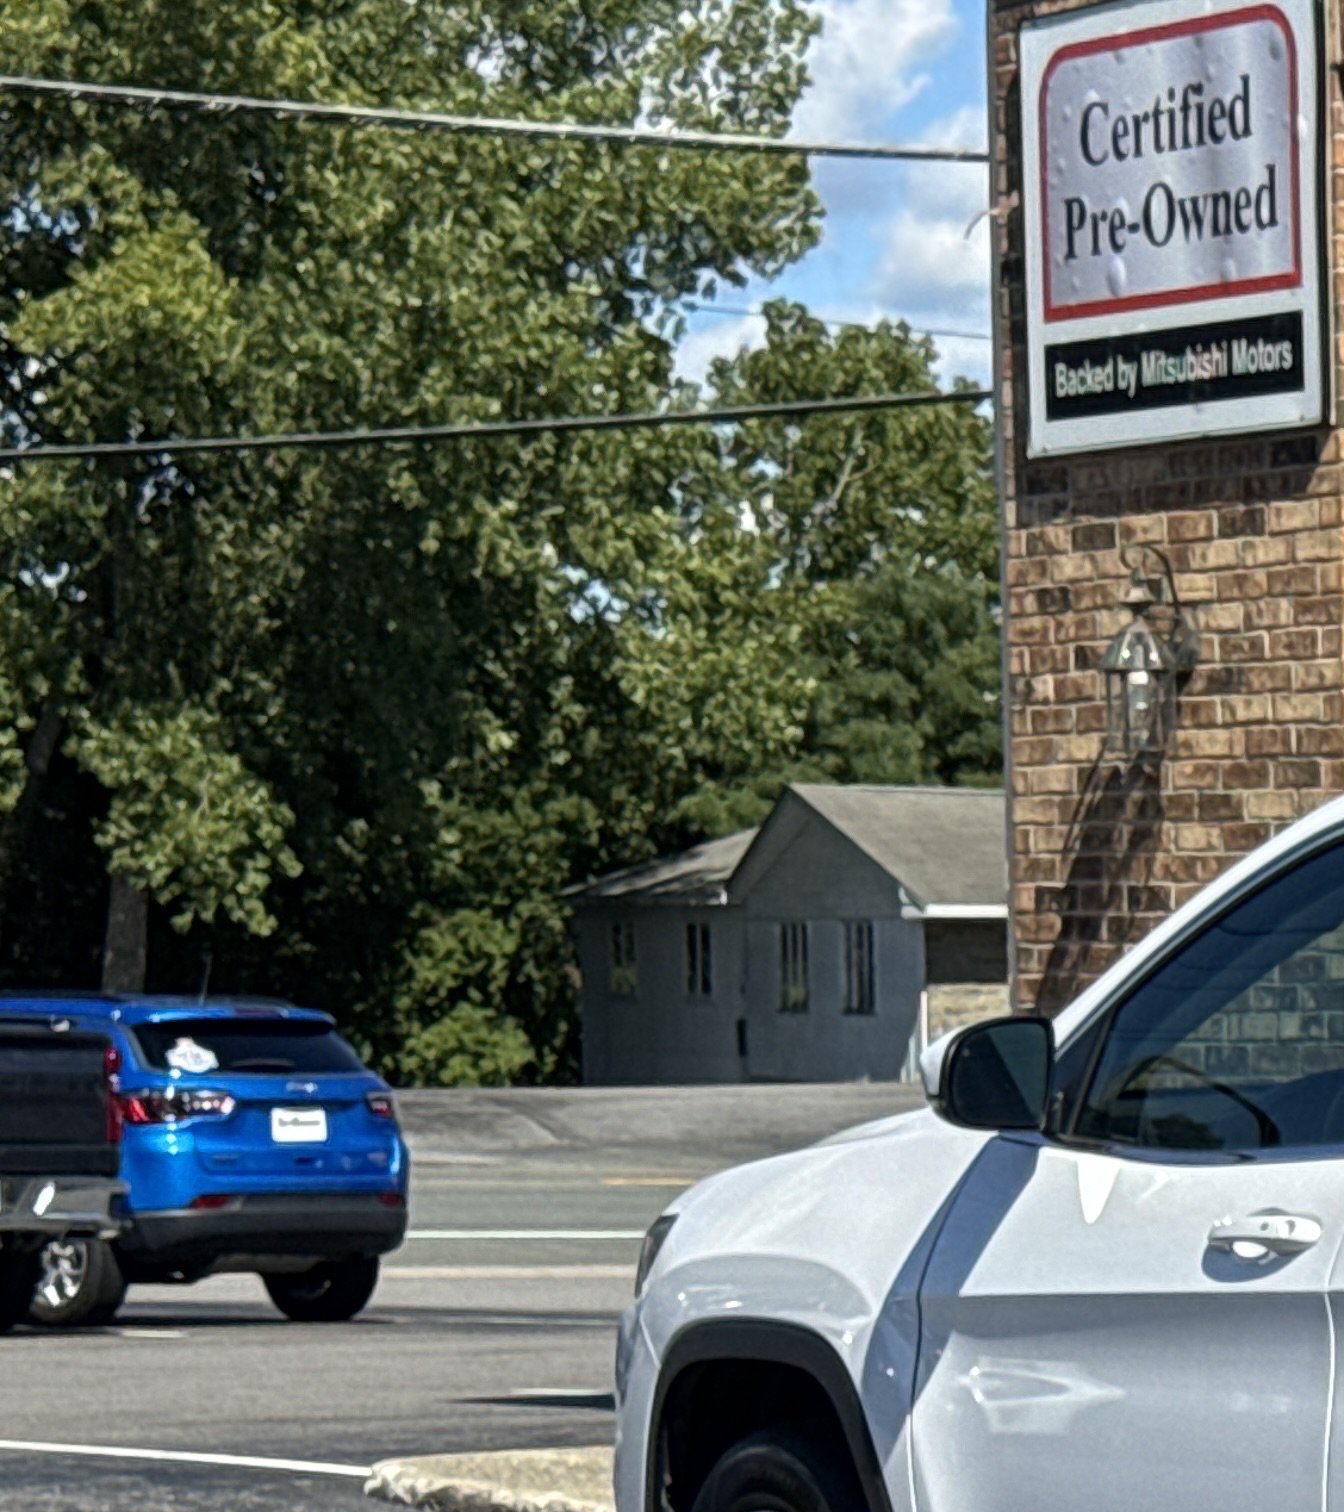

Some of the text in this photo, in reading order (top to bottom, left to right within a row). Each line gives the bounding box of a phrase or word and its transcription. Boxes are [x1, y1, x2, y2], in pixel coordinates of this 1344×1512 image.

[1080, 74, 1252, 166] Certified
[1064, 164, 1279, 260] Pre-Owned
[1054, 337, 1293, 398] Backed by Mitsubishi Motors
